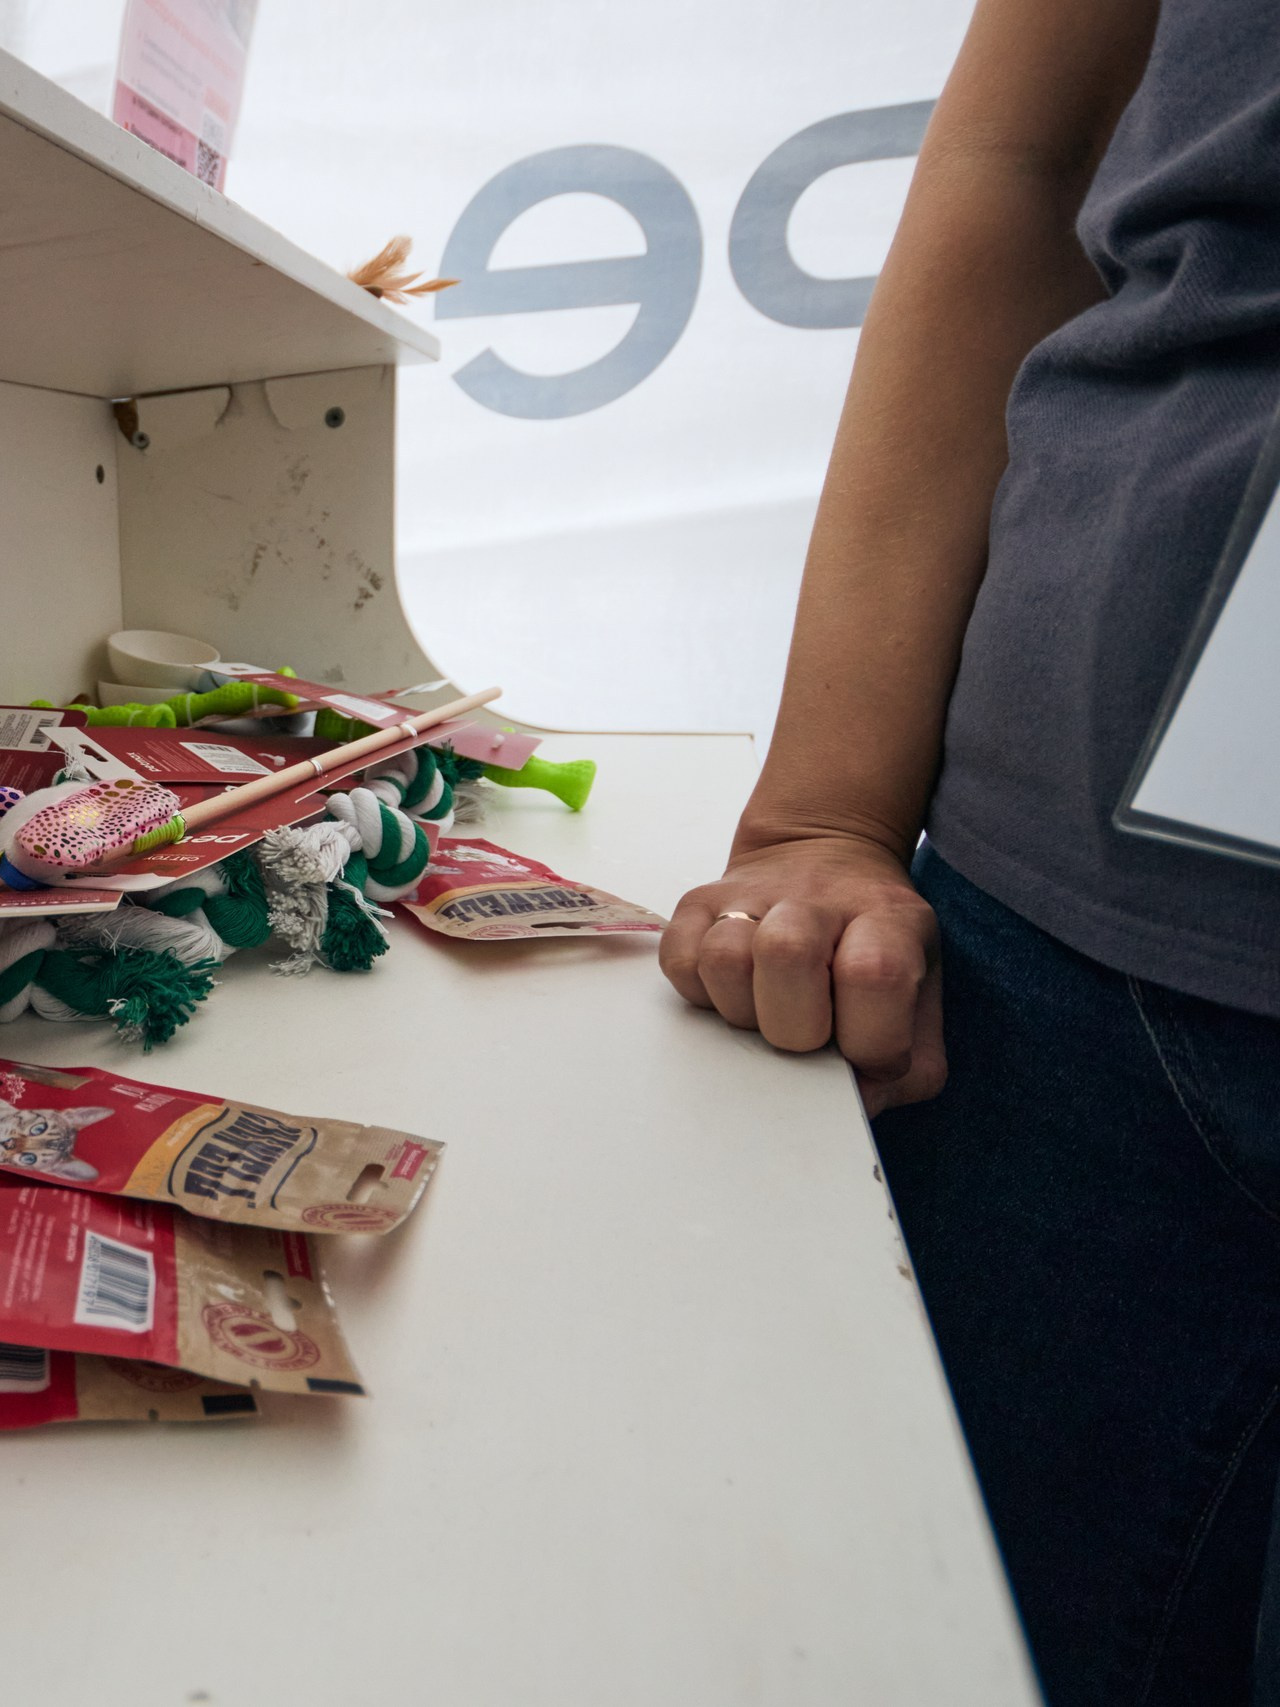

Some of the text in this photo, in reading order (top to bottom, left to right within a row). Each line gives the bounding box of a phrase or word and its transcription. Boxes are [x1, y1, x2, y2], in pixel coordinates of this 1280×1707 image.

[126, 752, 161, 773] petmax
[175, 832, 250, 844] pet
[169, 854, 200, 863] CAT
